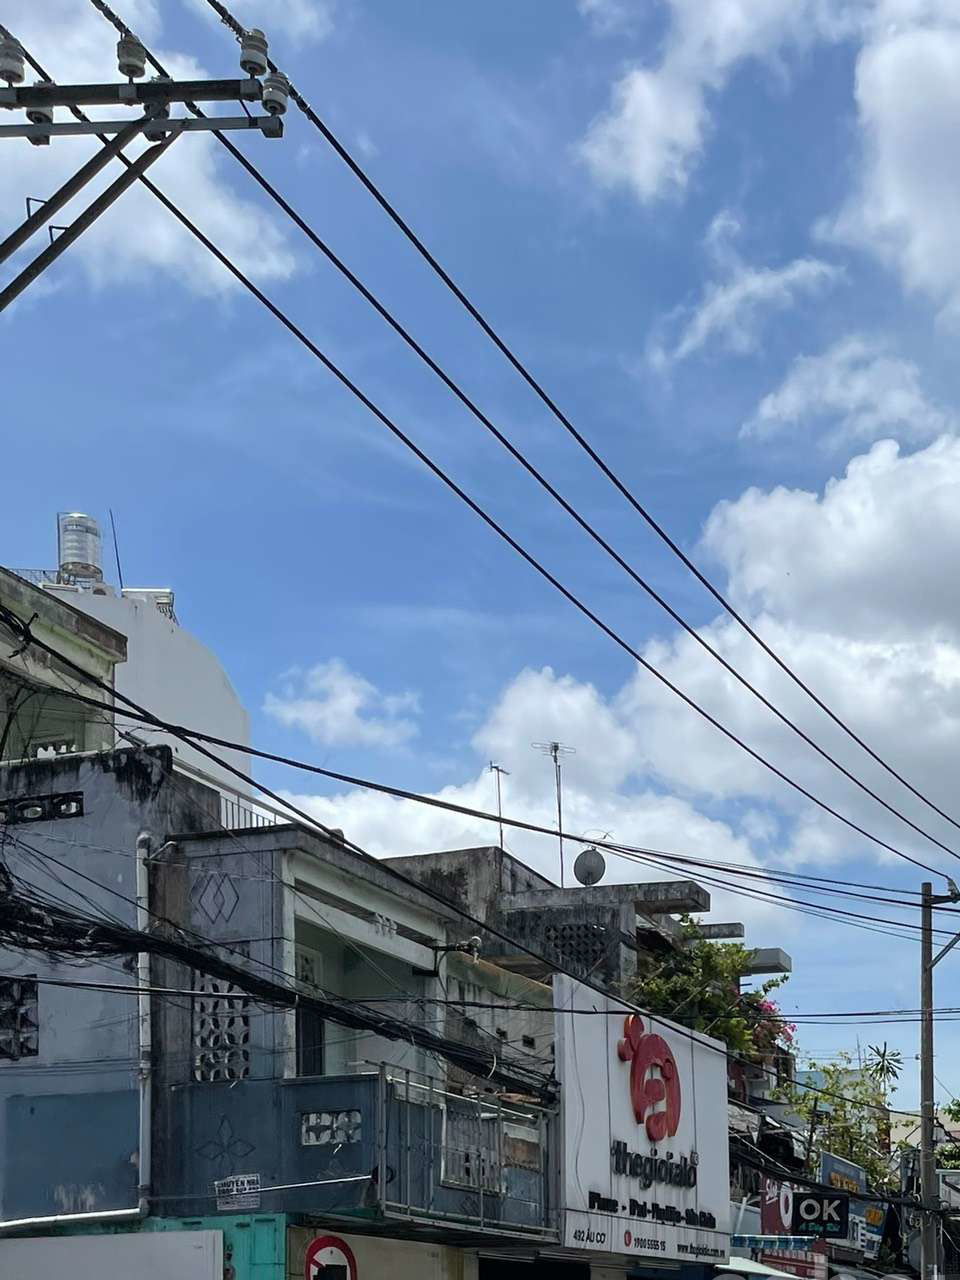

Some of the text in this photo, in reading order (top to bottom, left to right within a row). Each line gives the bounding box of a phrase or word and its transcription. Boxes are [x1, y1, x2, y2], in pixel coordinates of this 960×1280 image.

[799, 1198, 841, 1221] OK
[573, 1229, 585, 1242] 492
[586, 1228, 595, 1243] ÂU
[634, 1237, 666, 1251] 1900 5555 15
